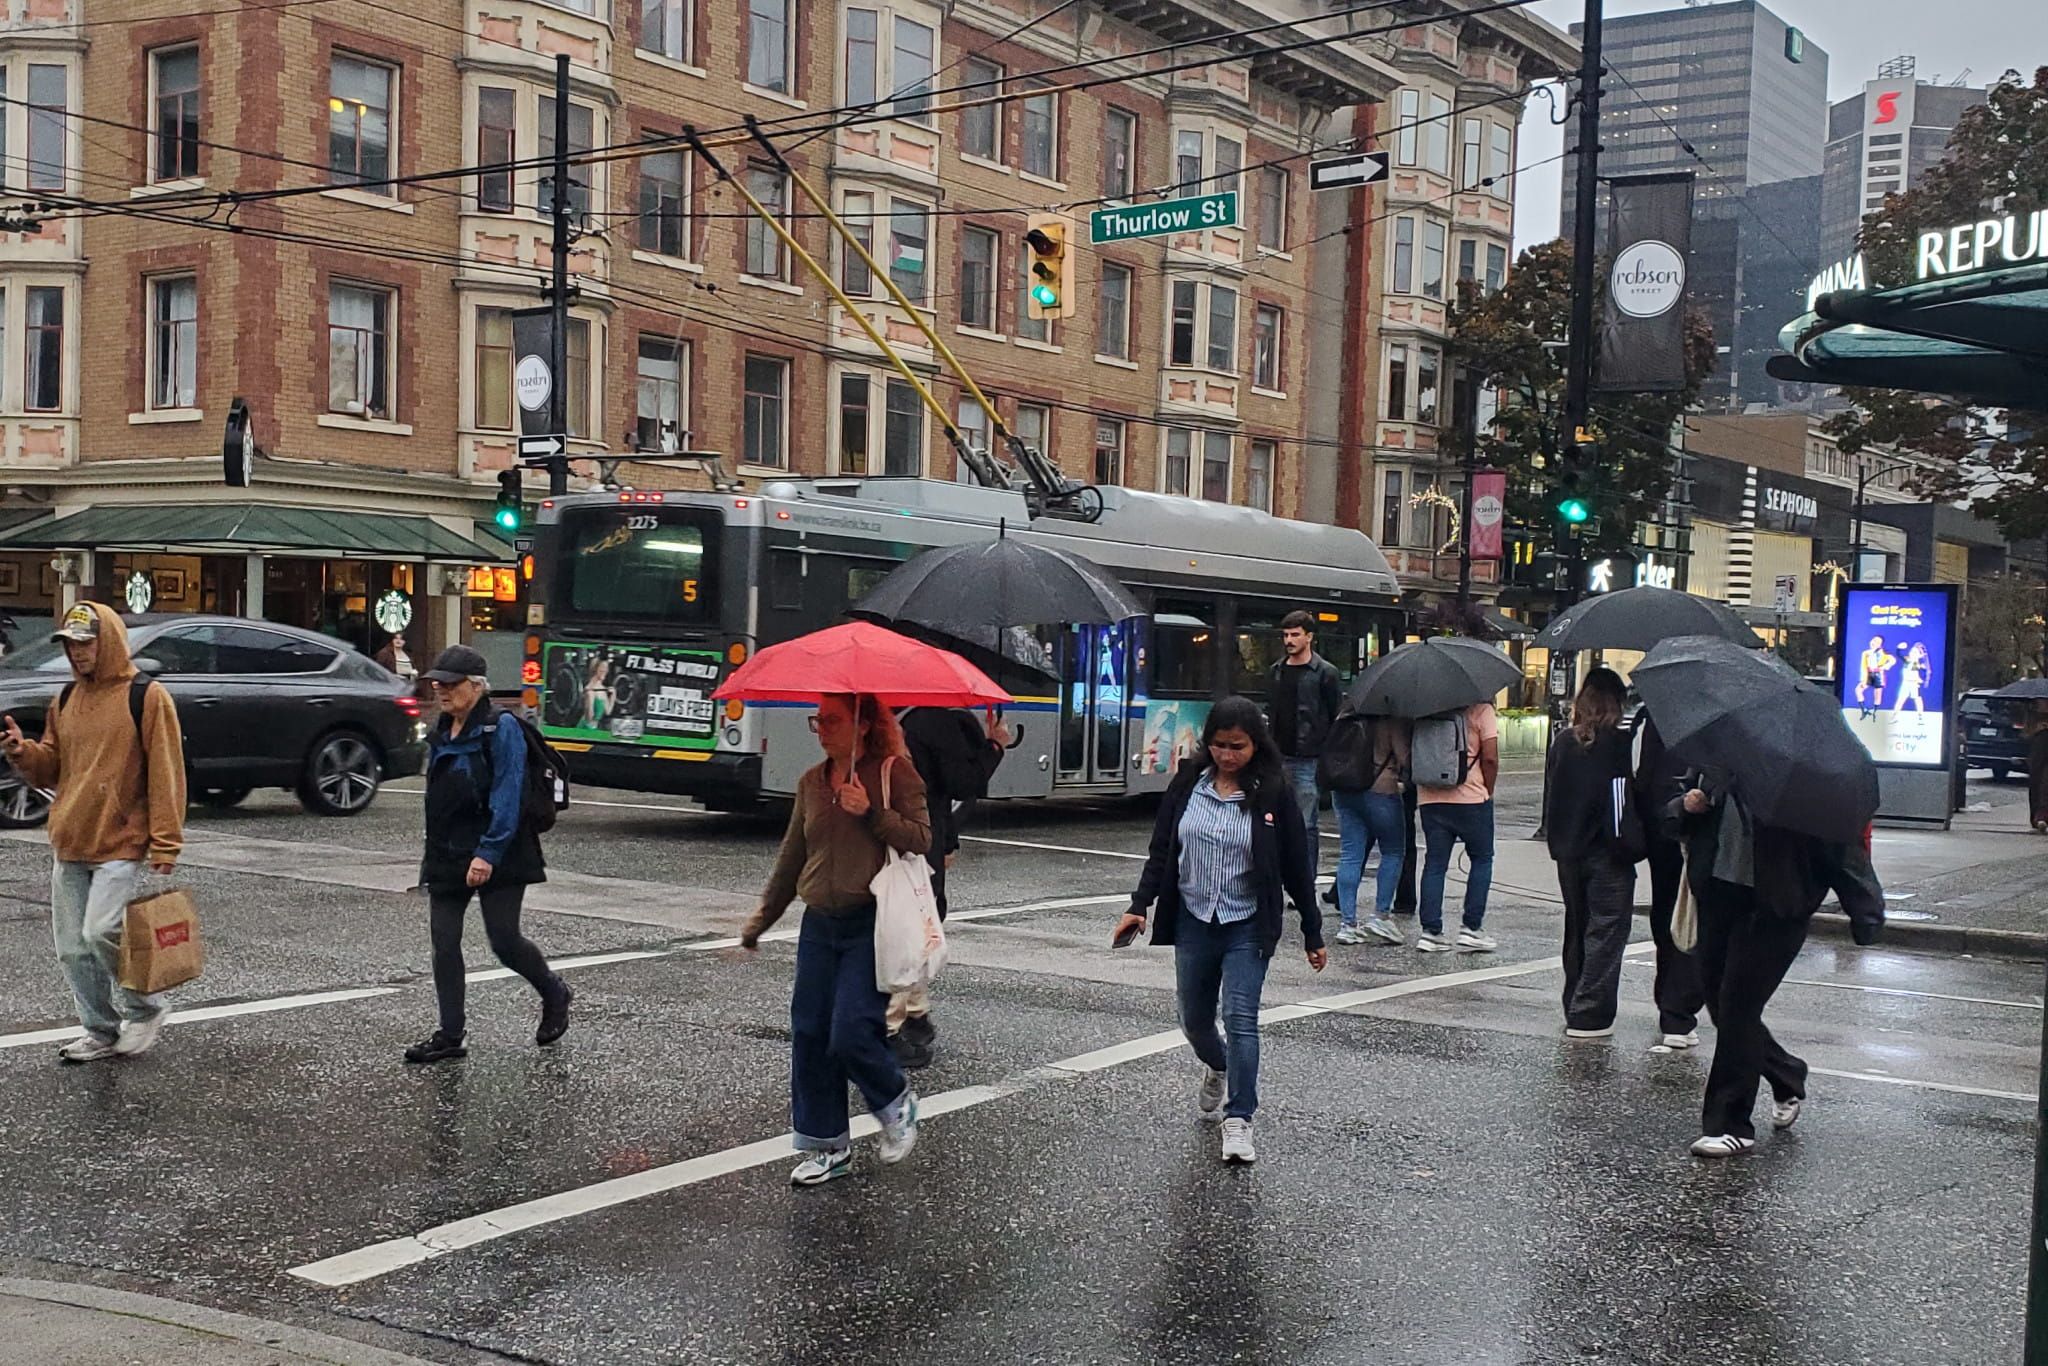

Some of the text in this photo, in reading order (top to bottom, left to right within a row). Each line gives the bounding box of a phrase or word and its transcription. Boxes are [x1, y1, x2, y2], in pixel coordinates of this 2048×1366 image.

[1101, 200, 1226, 236] Thurlow St
[1616, 258, 1682, 287] robson
[1764, 487, 1818, 518] SEPHORA
[1636, 553, 1675, 590] cker
[683, 580, 697, 602] 5
[625, 654, 675, 674] FINESS
